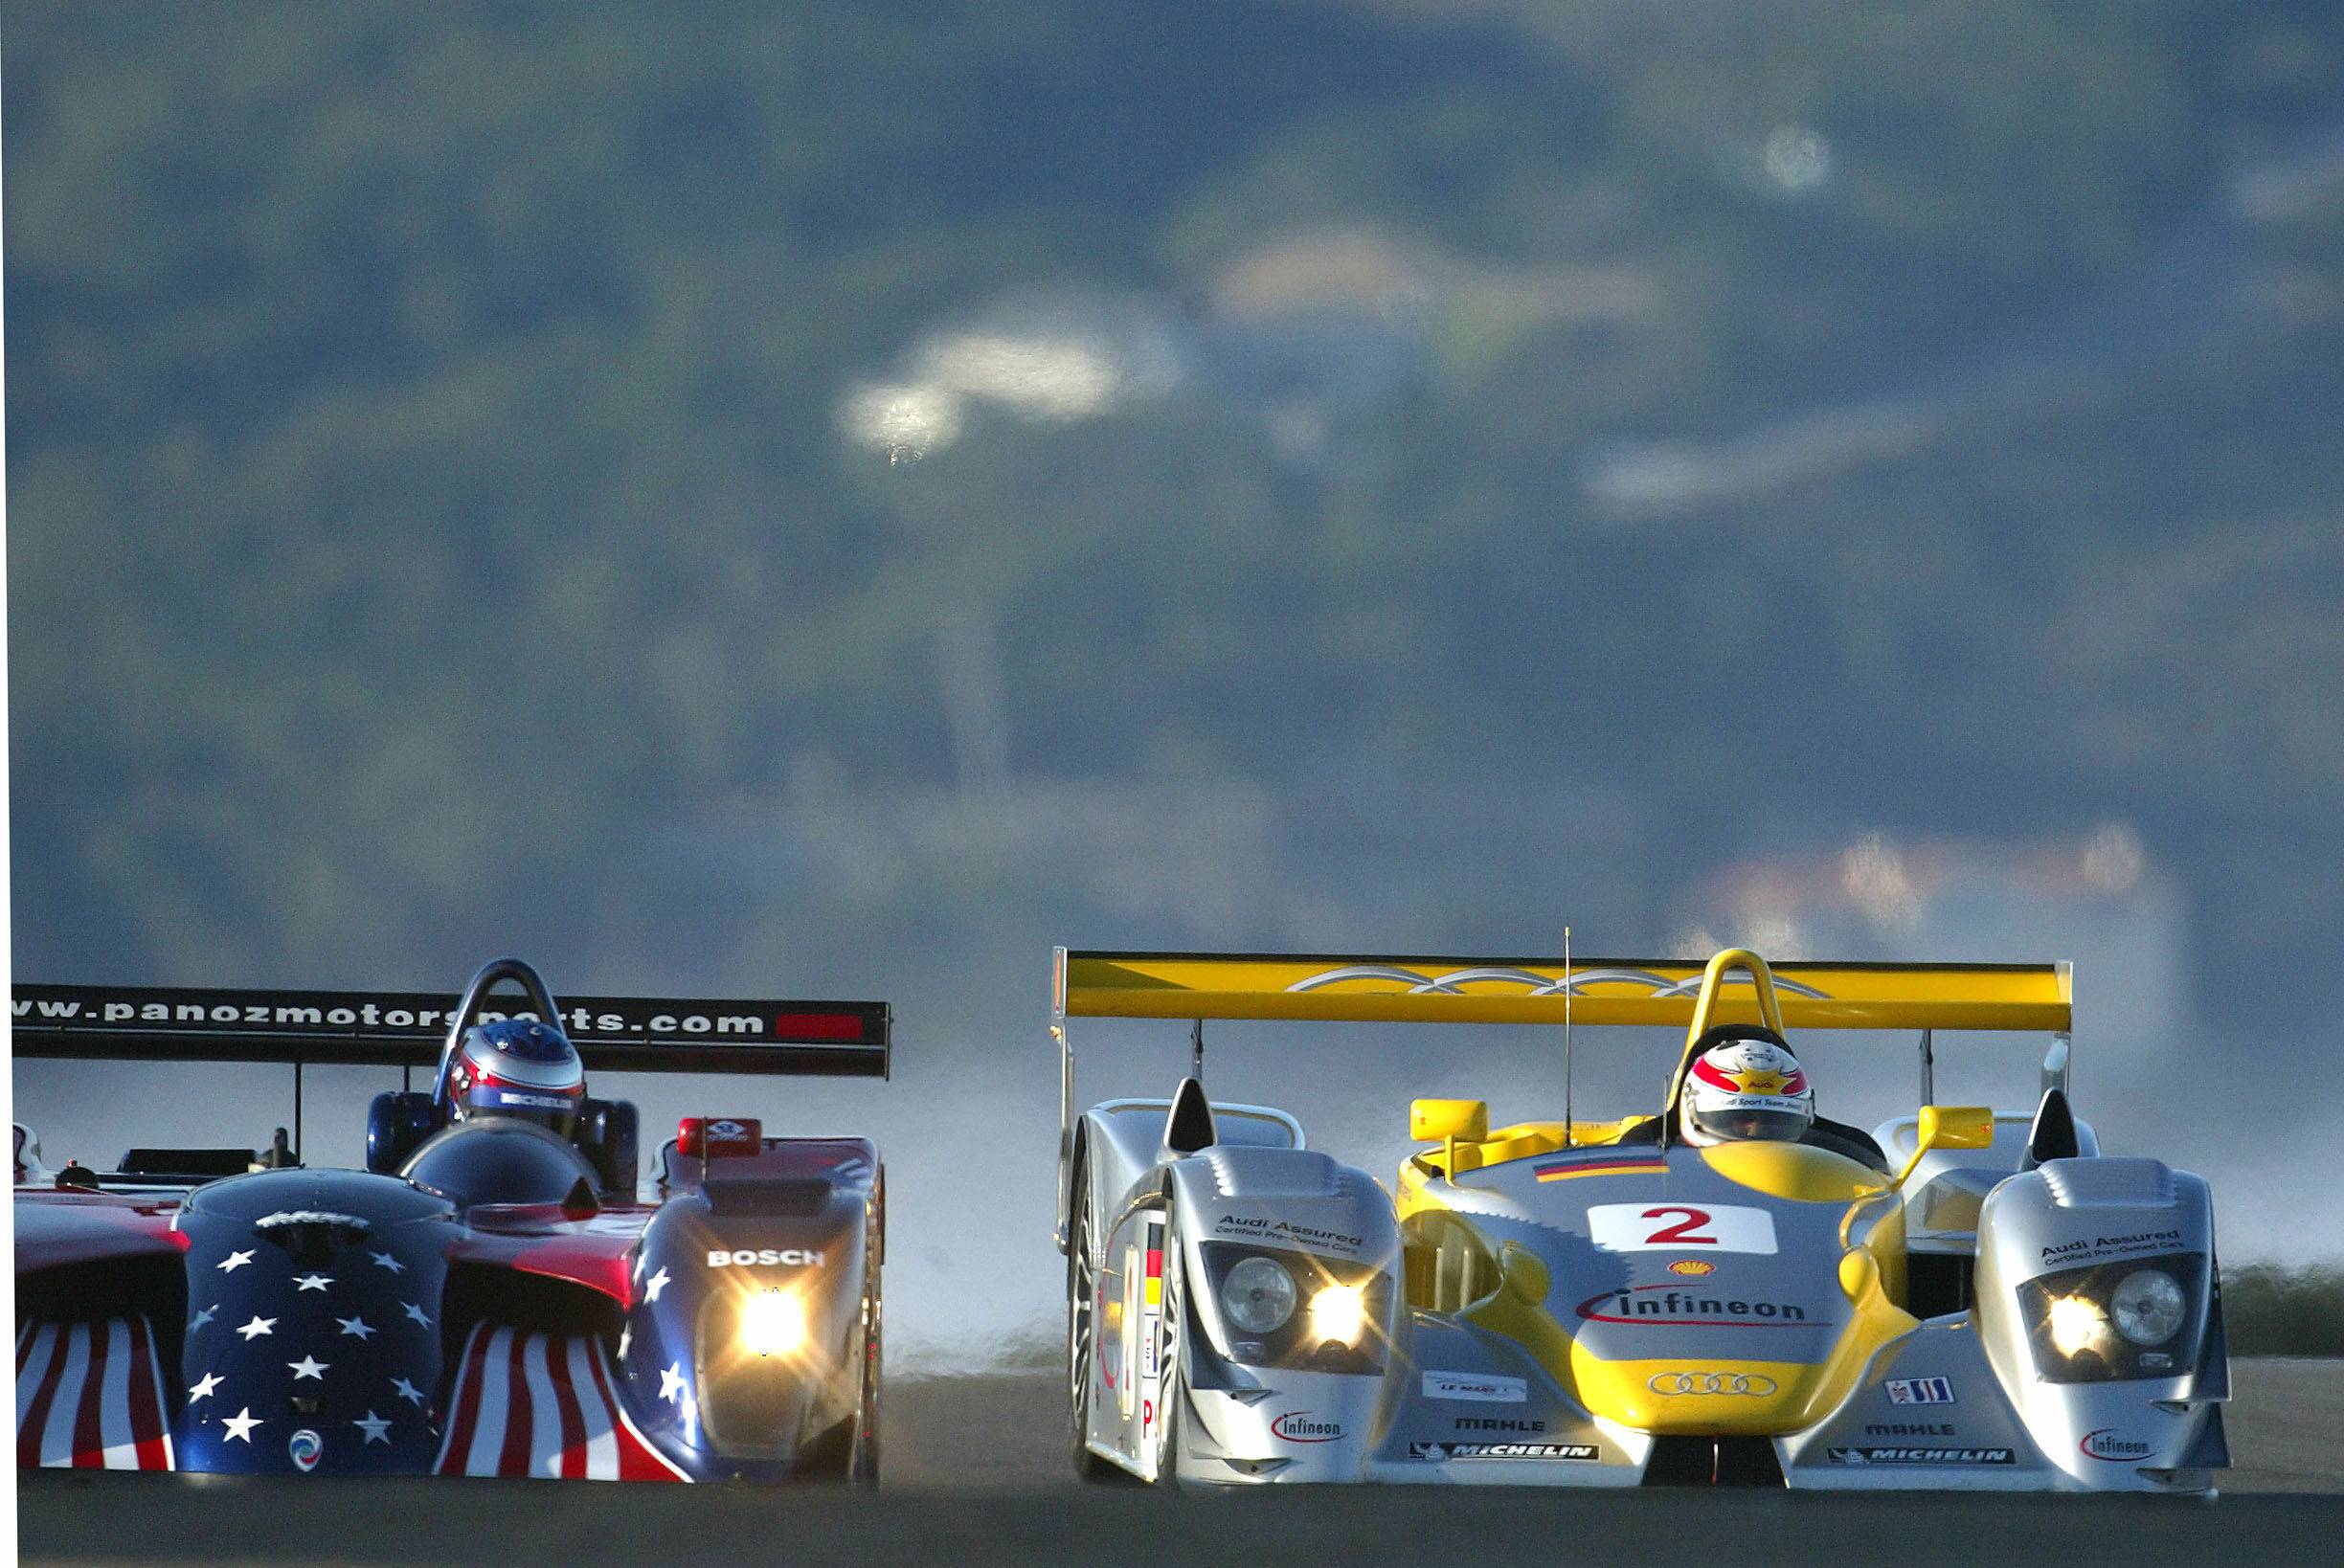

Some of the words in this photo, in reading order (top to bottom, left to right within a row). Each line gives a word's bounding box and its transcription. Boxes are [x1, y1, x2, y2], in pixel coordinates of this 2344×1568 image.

[1219, 1215, 1269, 1227] Audi
[1274, 1221, 1364, 1246] Assured
[1641, 1207, 1718, 1243] 2
[1215, 1225, 1262, 1237] Certified
[1265, 1231, 1329, 1247] Pre-Owned
[1332, 1243, 1357, 1255] Cars
[2041, 1240, 2088, 1257] Audi
[2096, 1229, 2180, 1246] Assured
[708, 1249, 825, 1267] BOSCH
[2044, 1252, 2092, 1266] Certified
[1455, 1418, 1545, 1432] MAHLE
[1866, 1423, 1955, 1436] MAHLE
[1452, 1445, 1593, 1457] MICHELIN
[1870, 1449, 2007, 1461] MICHELIN
